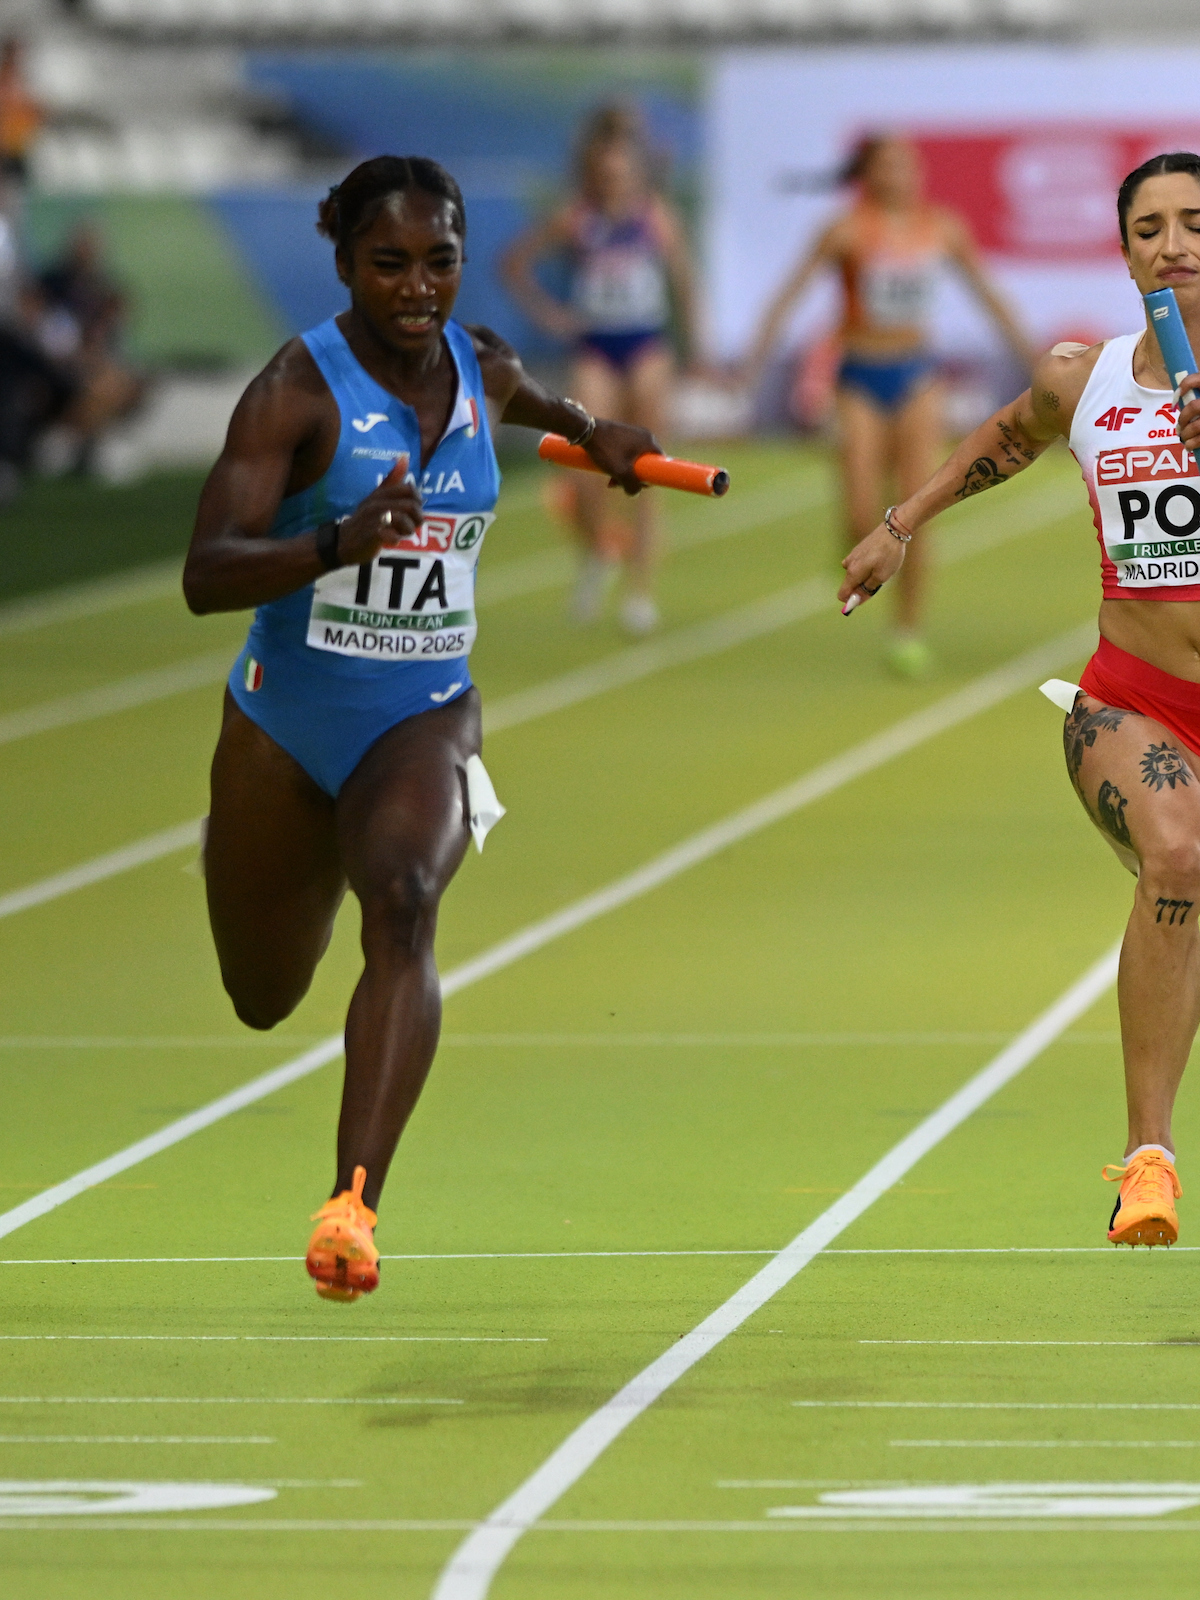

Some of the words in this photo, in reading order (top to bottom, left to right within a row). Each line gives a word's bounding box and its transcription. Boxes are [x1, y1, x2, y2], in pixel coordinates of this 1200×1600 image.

[1094, 406, 1142, 431] 4F
[376, 469, 466, 494] IALIA
[1141, 543, 1172, 557] RUN
[1125, 560, 1199, 580] MADRID
[355, 557, 449, 611] ITA
[357, 611, 393, 628] RUN
[324, 627, 417, 654] MADRID
[421, 633, 466, 654] 2025
[1155, 896, 1194, 926] 777
